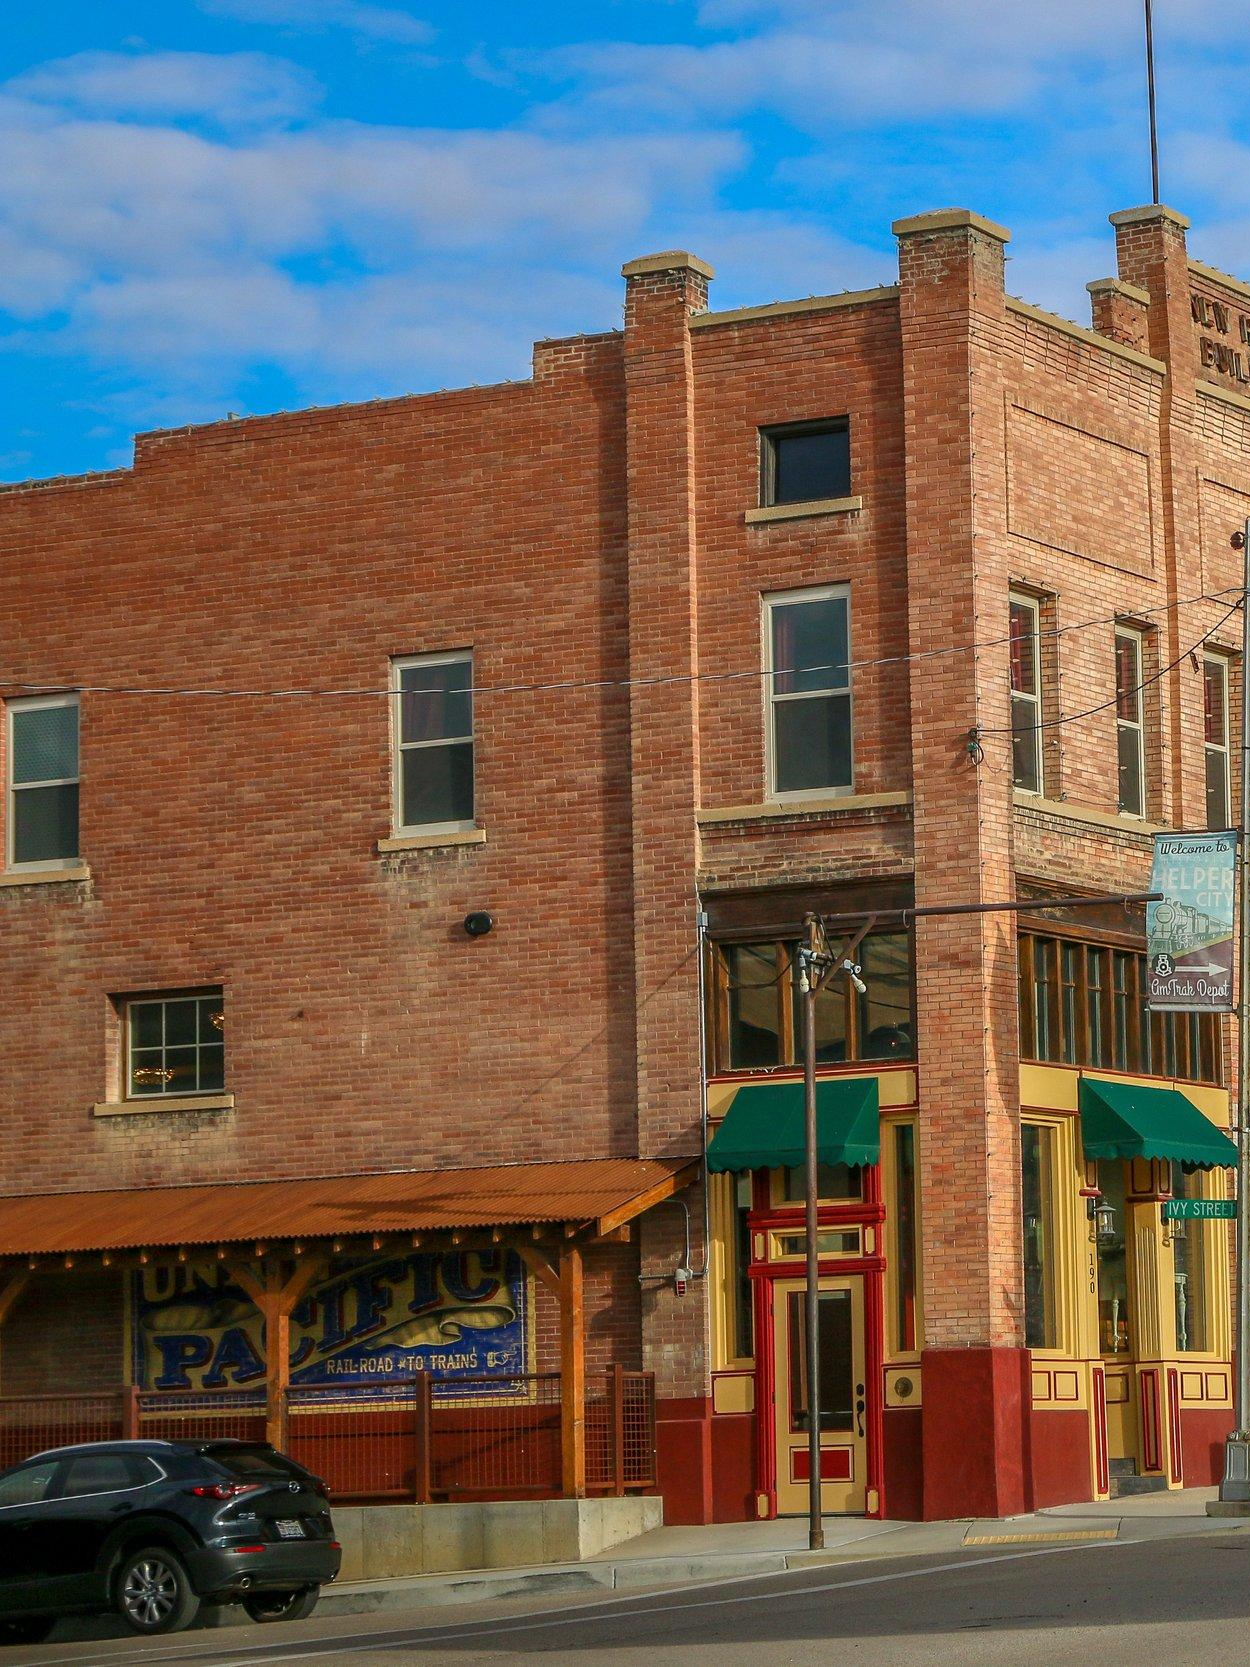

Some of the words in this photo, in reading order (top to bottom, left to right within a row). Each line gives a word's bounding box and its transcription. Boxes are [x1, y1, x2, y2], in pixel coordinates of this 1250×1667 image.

[1160, 842, 1213, 855] Welcome
[1216, 840, 1230, 852] to
[1151, 867, 1234, 891] HELPER
[1196, 892, 1233, 907] CITY
[1196, 978, 1231, 1004] Depot
[1168, 1202, 1187, 1216] IVY
[1193, 1202, 1235, 1216] STREET
[406, 1355, 424, 1371] TO
[430, 1353, 478, 1370] TRAINS
